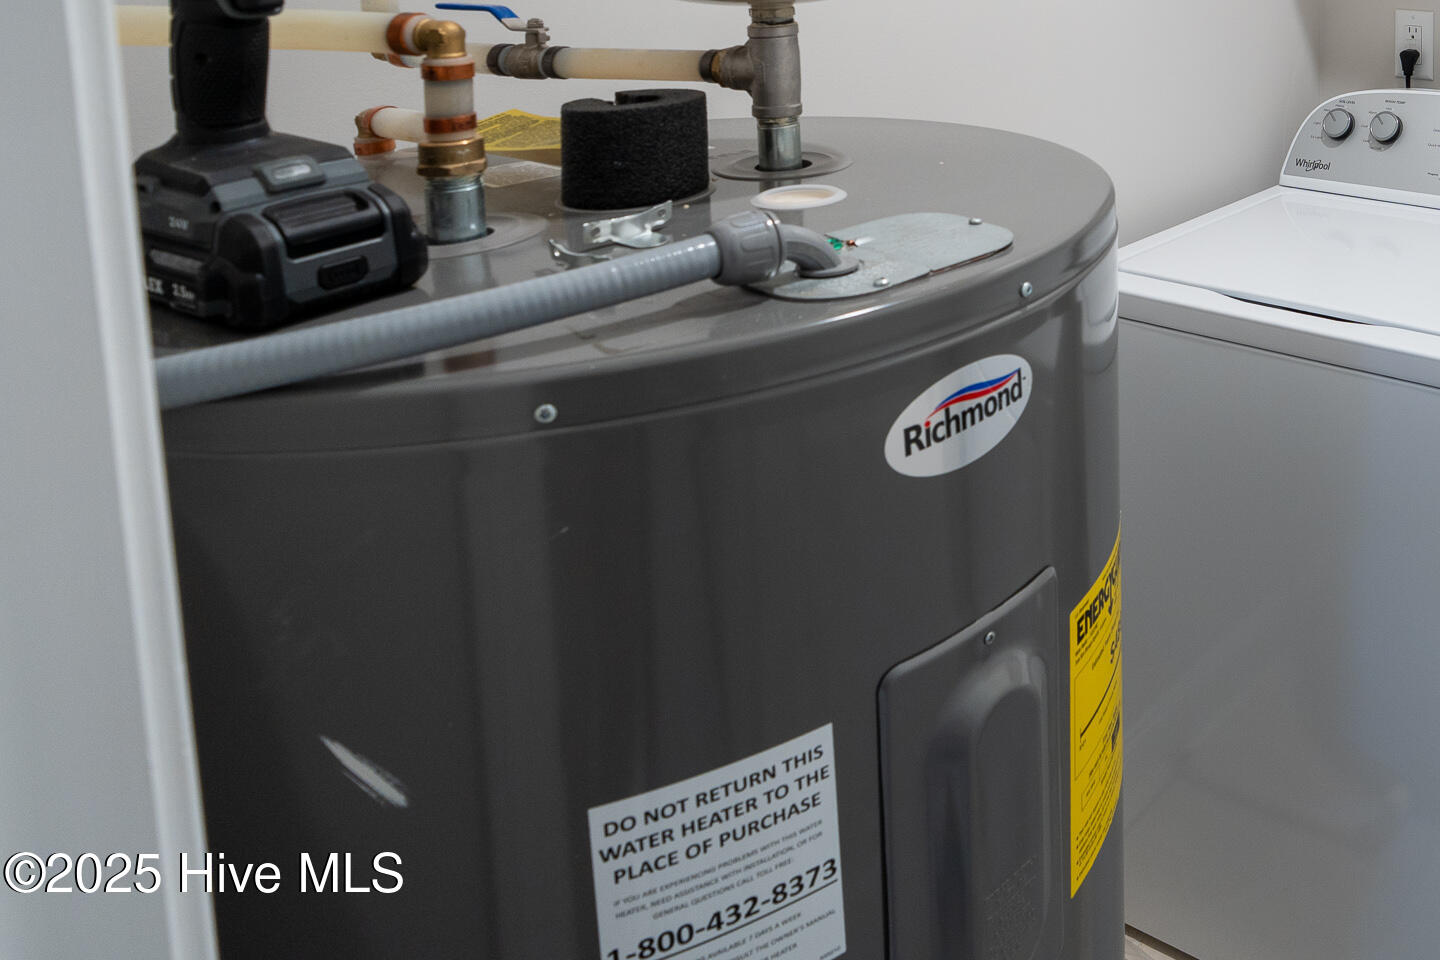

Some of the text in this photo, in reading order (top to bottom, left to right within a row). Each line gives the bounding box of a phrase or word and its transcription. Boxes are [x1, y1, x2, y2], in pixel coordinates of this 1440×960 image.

[1295, 158, 1331, 172] Whirlpool
[903, 368, 1023, 458] Richmond
[599, 765, 831, 864] WATER HEATER TO THE
[603, 744, 824, 838] DO NOT RETURN THIS
[614, 792, 822, 885] PLACE OF PURCHASE
[622, 894, 641, 904] YOU
[642, 888, 658, 898] ARE
[659, 866, 717, 892] EXPERIENCING
[718, 849, 758, 869] PROBLEMS
[760, 840, 780, 852] WITH
[782, 831, 798, 842] THIS
[799, 820, 822, 834] WATER
[650, 895, 673, 908] NEED
[674, 877, 720, 898] ASSISTANCE
[721, 868, 743, 881] WITH
[796, 838, 808, 848] OR
[808, 831, 822, 842] FOR
[607, 857, 838, 960] 1-800-432-8373
[652, 902, 689, 920] GENERAL
[690, 883, 735, 906] QUESTIONS
[736, 876, 754, 887] CALL
[756, 868, 772, 878] TOLL
[755, 926, 774, 940] DAYS
[782, 912, 802, 926] WEEK
[755, 942, 770, 954] THE
[806, 908, 836, 928] MANUAL
[770, 942, 798, 960] HEATER
